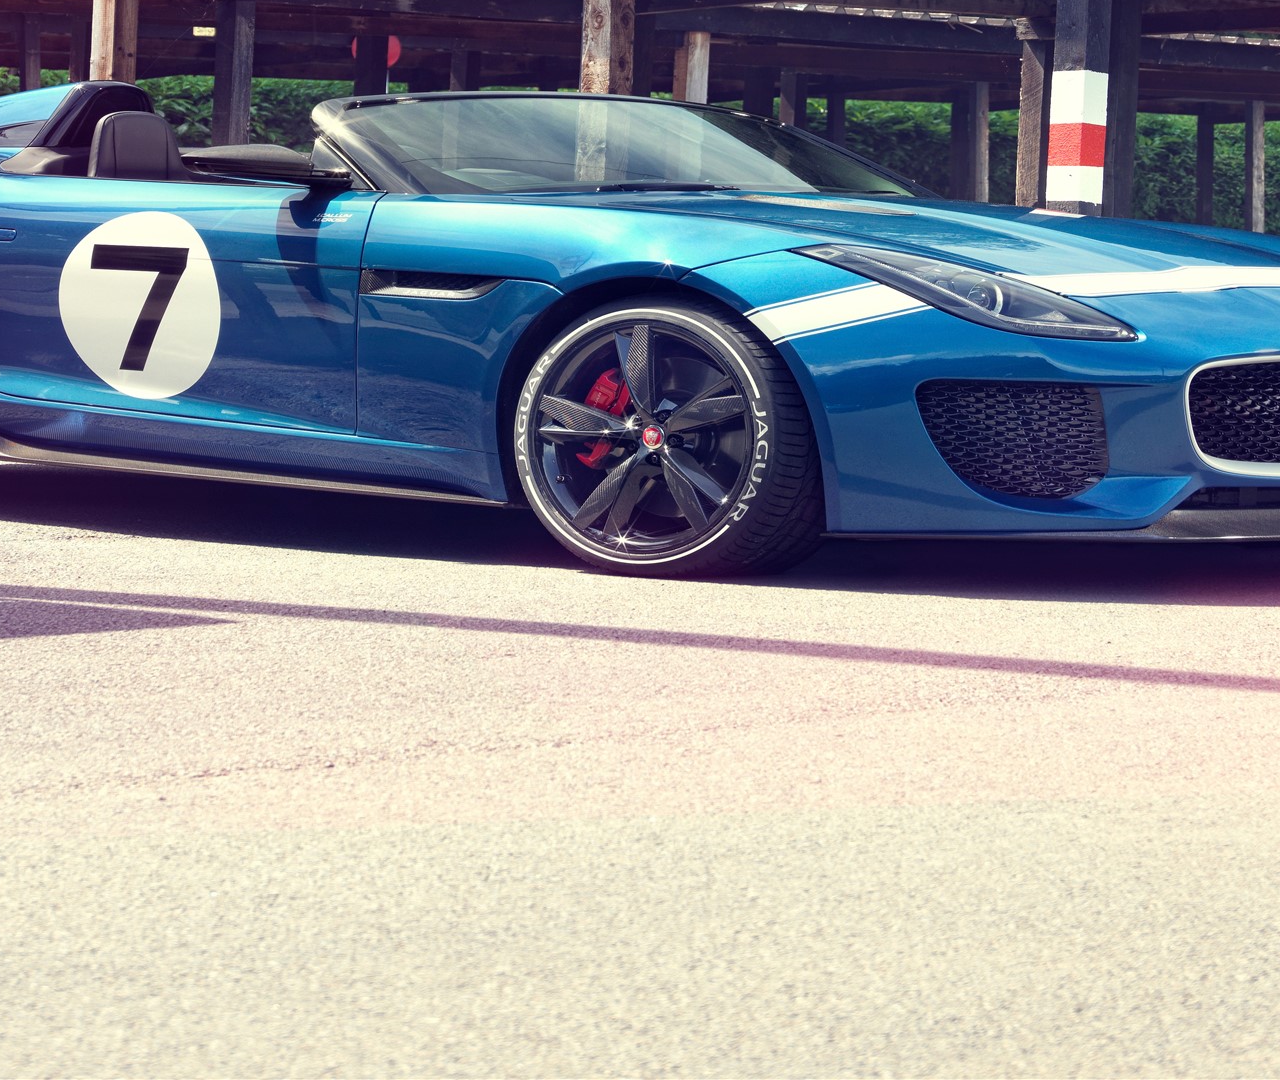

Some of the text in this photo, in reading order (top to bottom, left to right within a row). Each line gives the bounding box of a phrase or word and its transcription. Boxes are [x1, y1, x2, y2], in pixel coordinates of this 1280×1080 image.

[90, 243, 190, 372] 7
[517, 355, 550, 471] JAGUAR
[729, 401, 769, 522] JAGUAR
